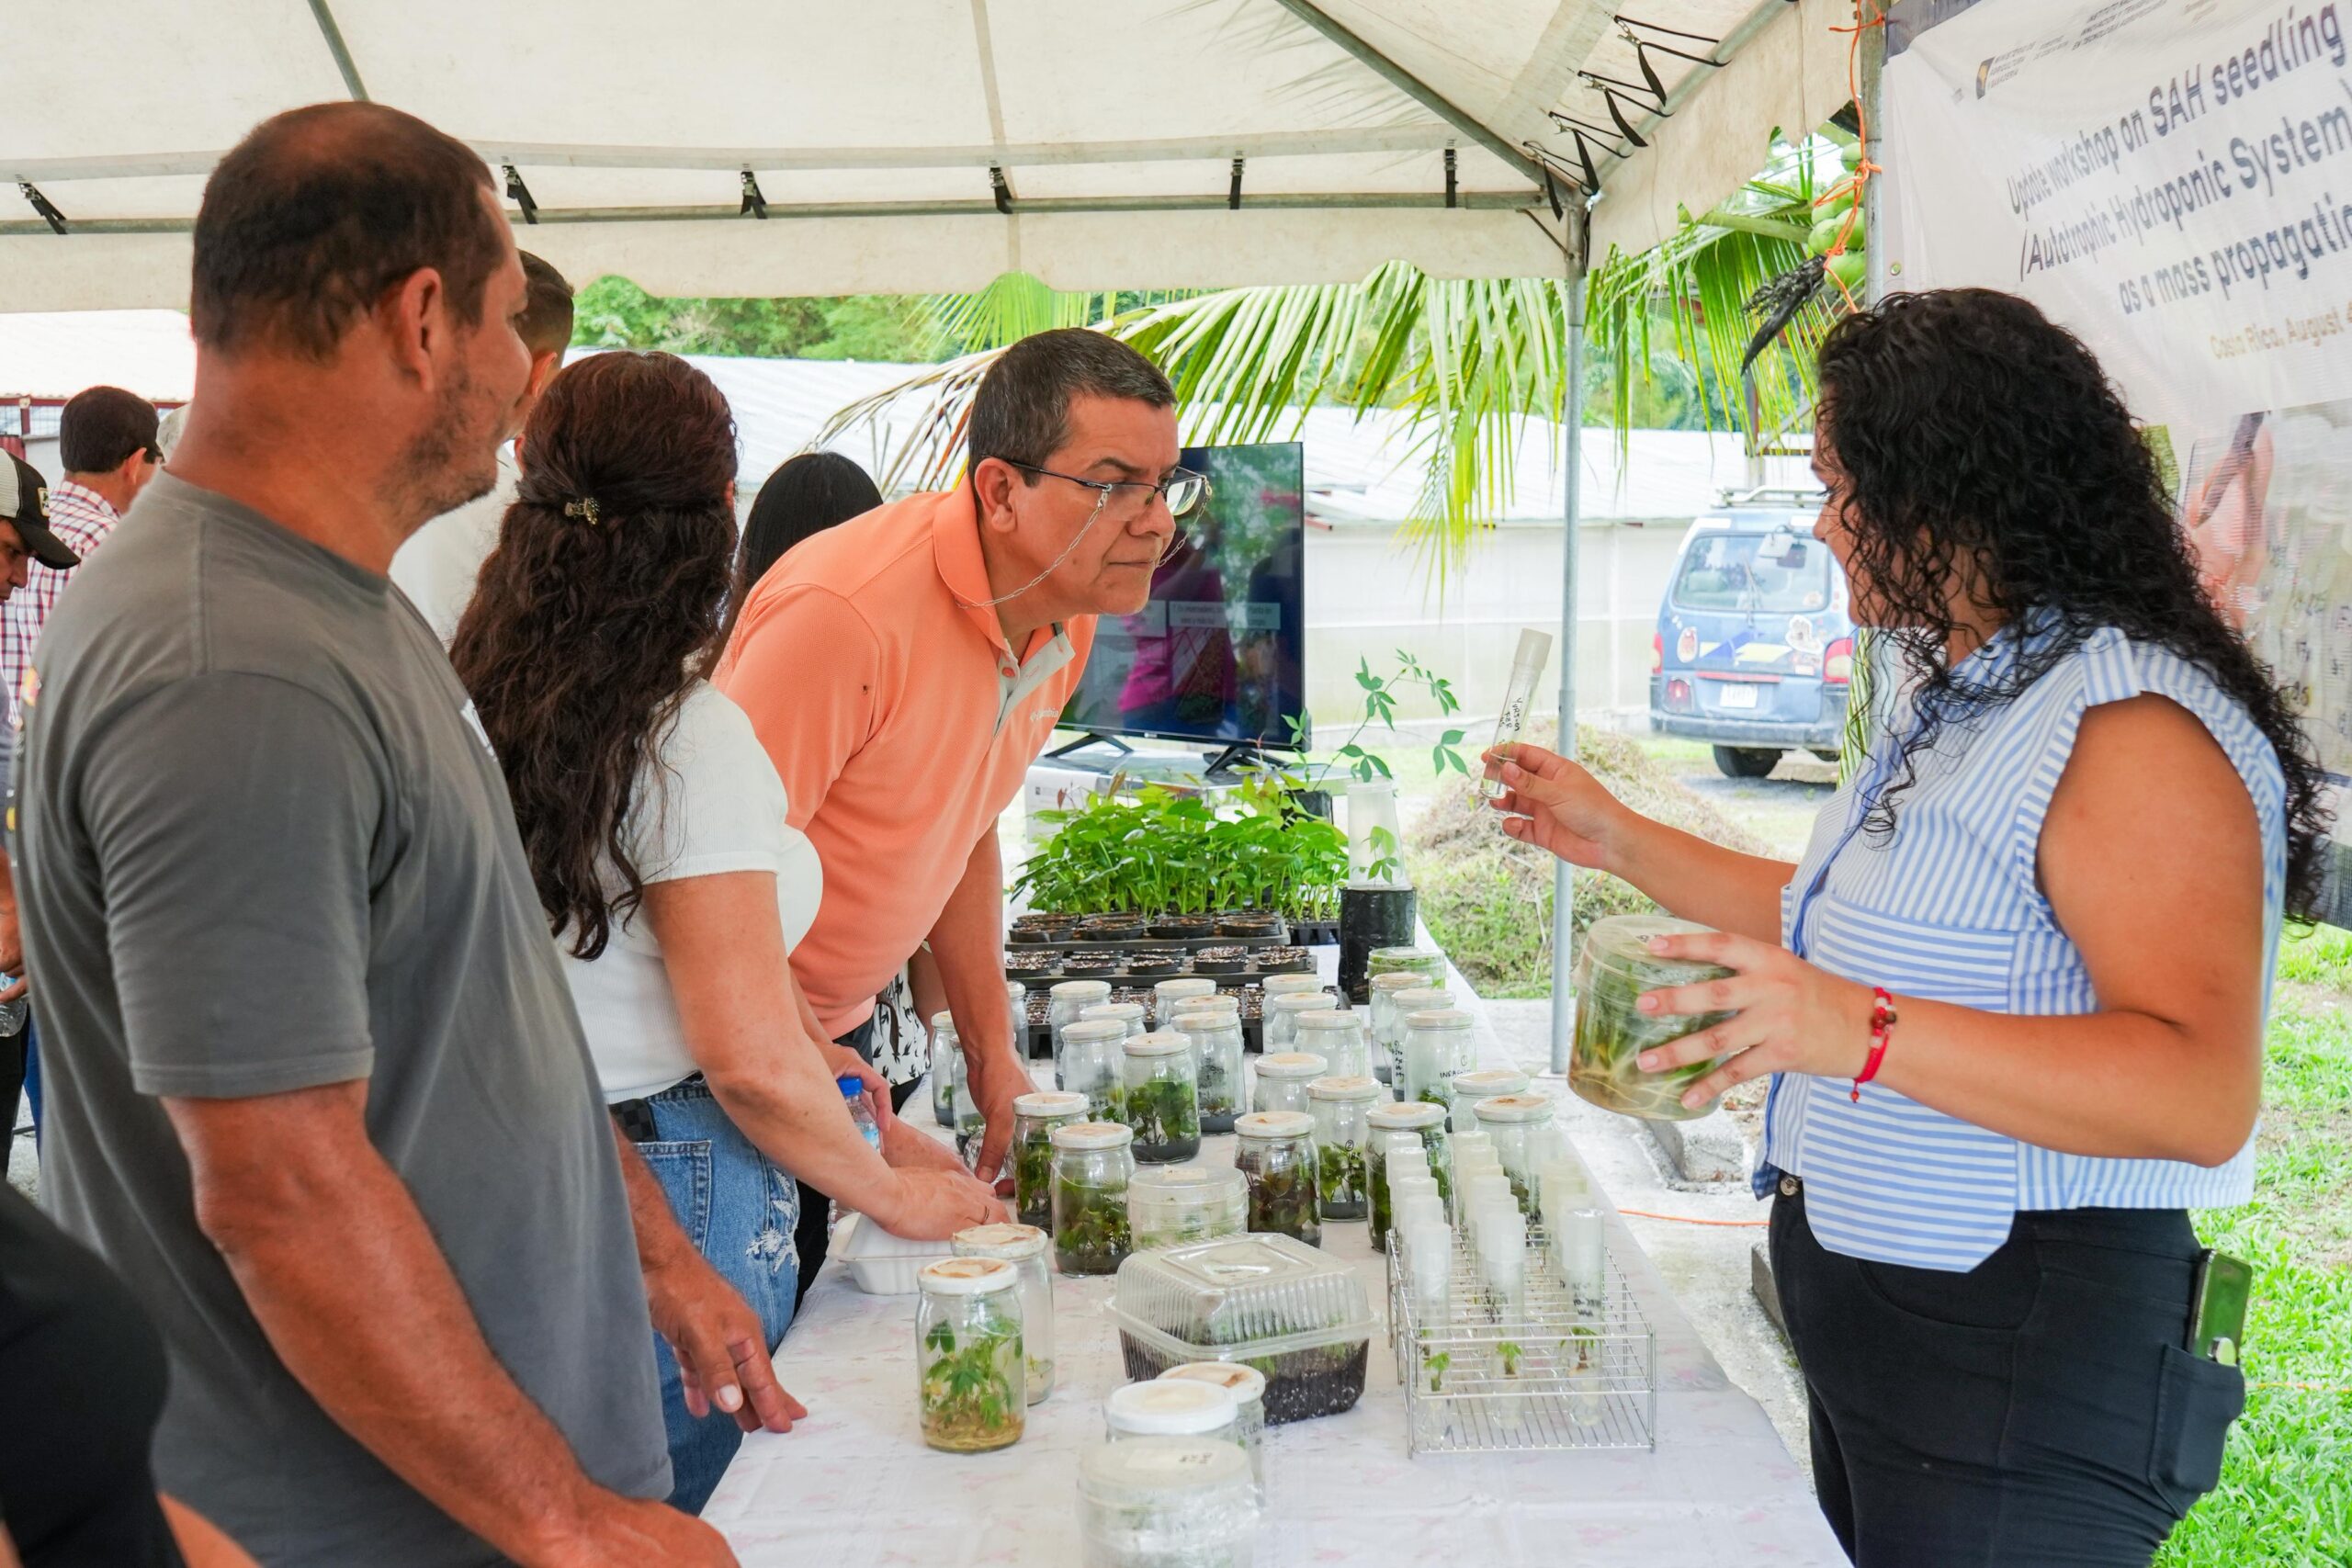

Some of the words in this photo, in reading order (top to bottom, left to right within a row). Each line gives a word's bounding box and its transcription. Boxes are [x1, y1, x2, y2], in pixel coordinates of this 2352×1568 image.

[2007, 164, 2052, 221] Update
[2043, 126, 2120, 191] workshop
[2120, 108, 2149, 152] on
[2150, 62, 2207, 137] SAH
[2212, 3, 2346, 106] seedling
[2108, 149, 2232, 246] Hydroponic
[2119, 279, 2141, 315] as
[2141, 275, 2155, 308] a
[2154, 256, 2211, 304] mass
[2286, 306, 2344, 347] August
